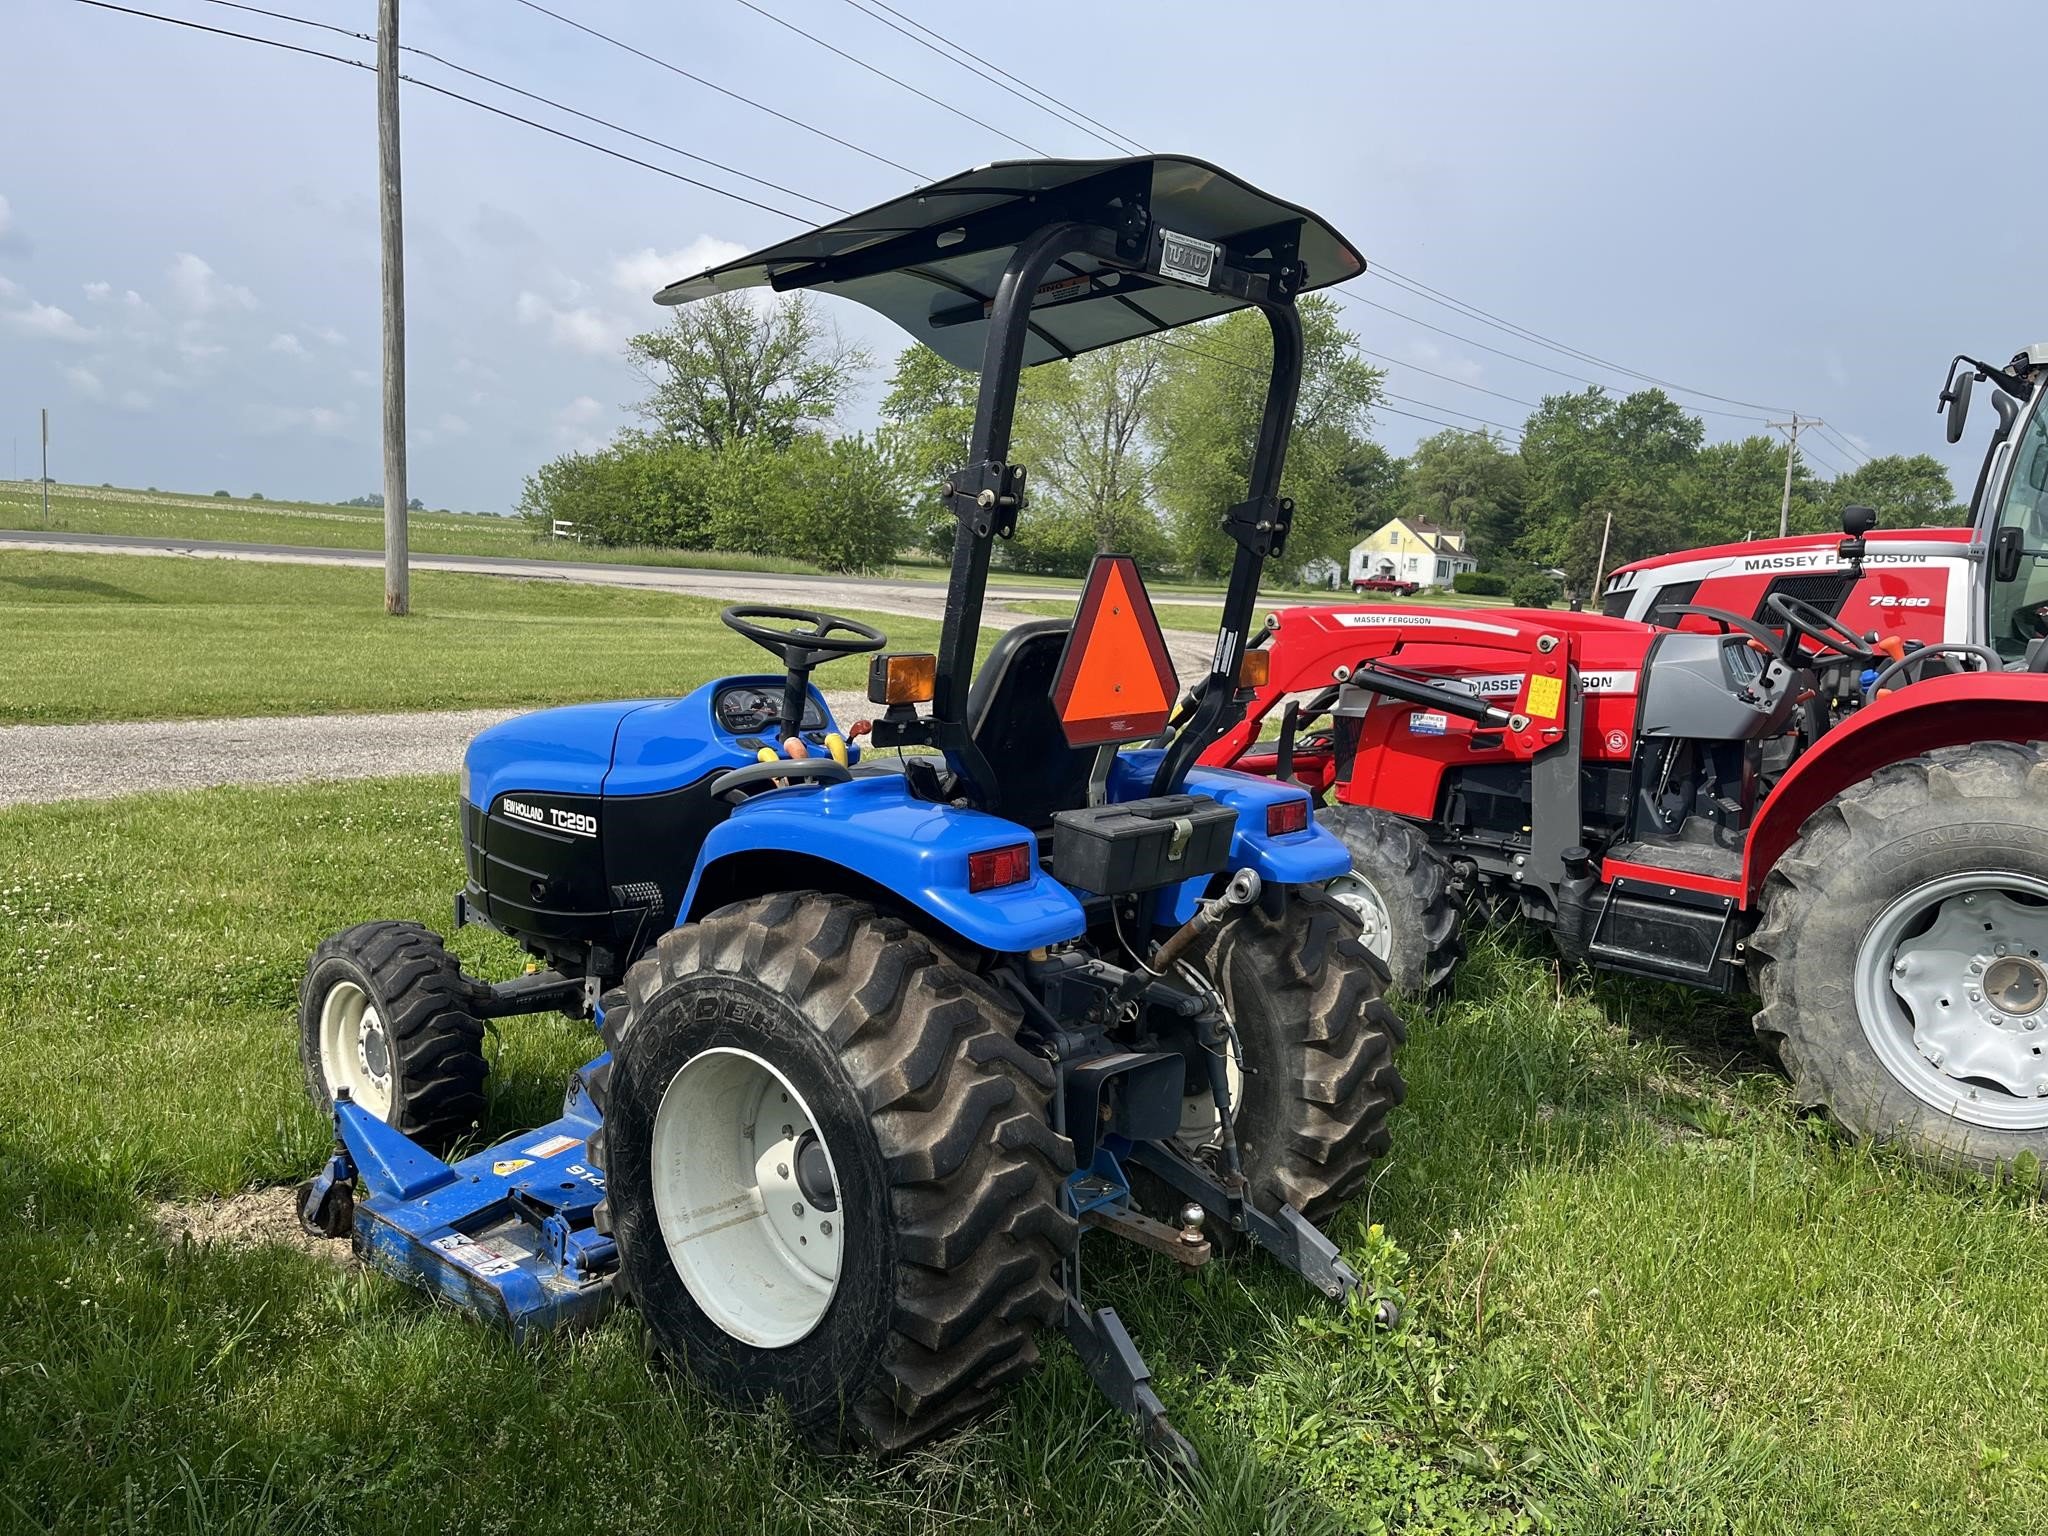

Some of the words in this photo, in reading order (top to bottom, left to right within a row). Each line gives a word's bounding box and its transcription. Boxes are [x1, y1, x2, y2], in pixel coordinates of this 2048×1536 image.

[1745, 555, 1819, 571] MASSEY
[1388, 616, 1431, 624] FERGUSON
[503, 797, 516, 814] NEW
[515, 801, 544, 822] HOLLAND
[550, 808, 597, 833] TC29D
[1894, 823, 2048, 858] GALAX
[565, 1164, 606, 1190] 914
